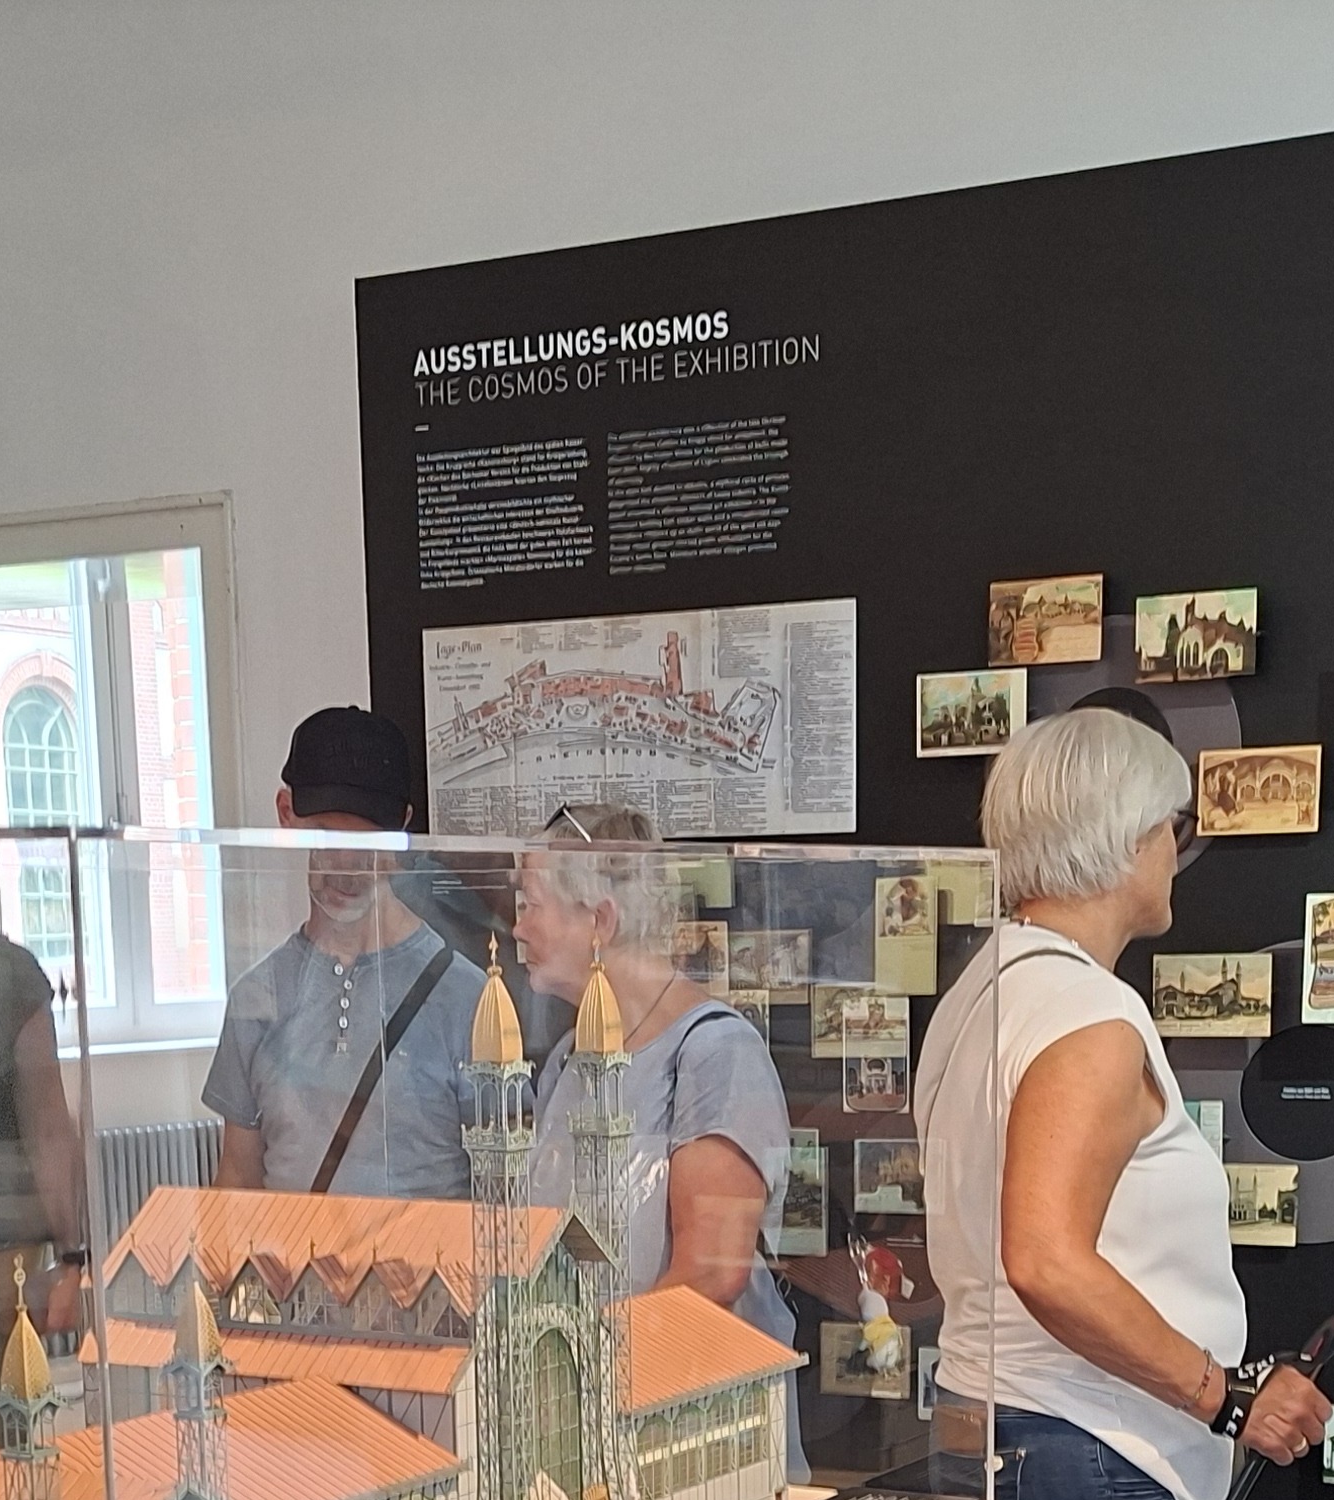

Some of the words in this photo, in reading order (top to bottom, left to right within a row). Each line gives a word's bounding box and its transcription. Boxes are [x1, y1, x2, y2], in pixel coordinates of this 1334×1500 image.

[413, 310, 730, 377] AUSSTELLUNGS-KOSMOS
[415, 376, 462, 408] THE
[468, 363, 569, 404] COSMOS
[577, 358, 610, 391] OF
[615, 352, 666, 386] THE
[674, 333, 821, 379] EXHIBITION
